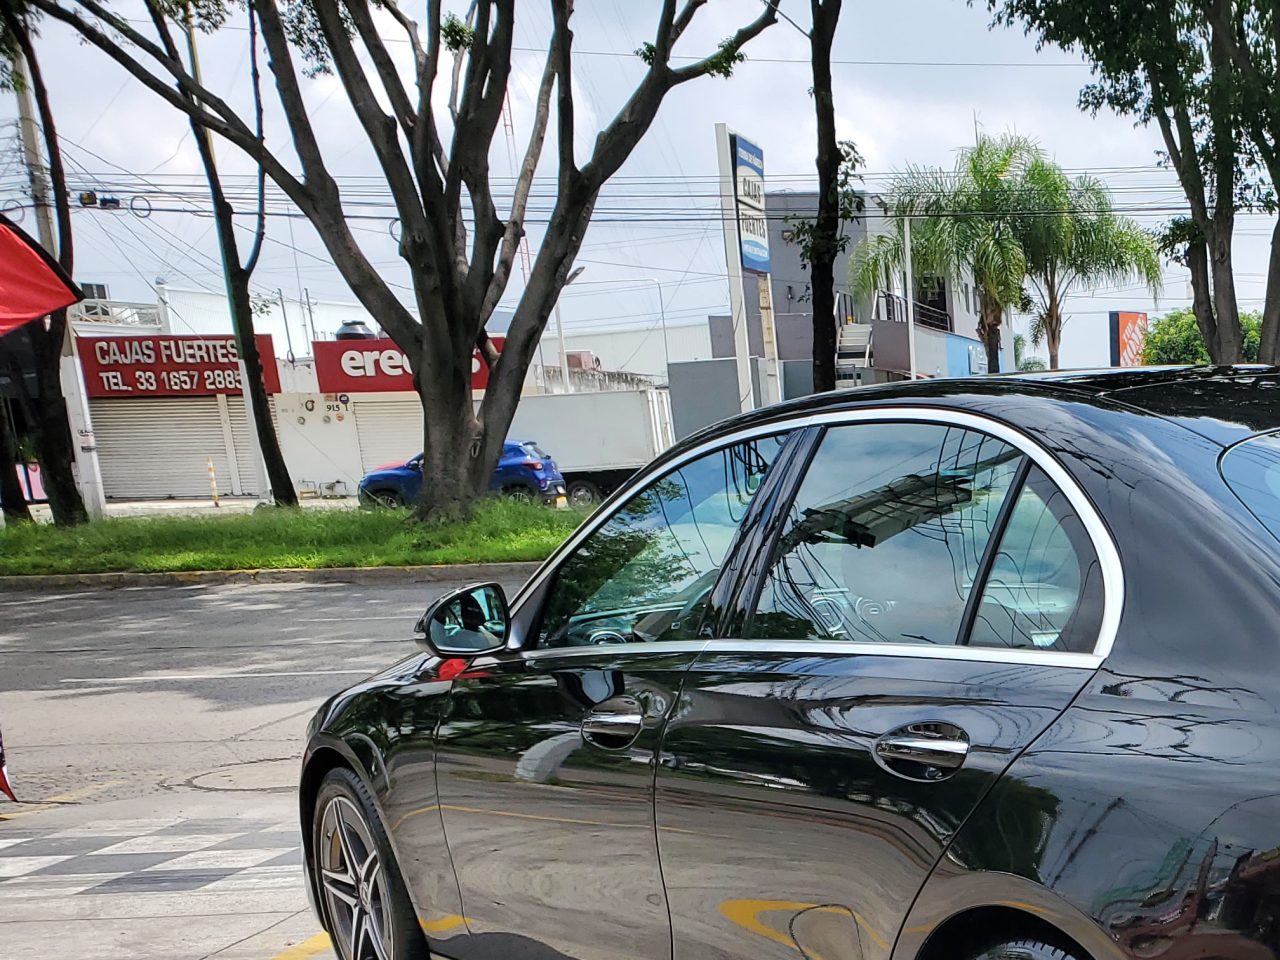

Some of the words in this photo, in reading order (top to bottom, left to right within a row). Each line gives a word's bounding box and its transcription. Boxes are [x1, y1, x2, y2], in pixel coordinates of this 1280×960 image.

[742, 177, 761, 204] CAJAS
[95, 340, 156, 365] CAJAS
[159, 339, 238, 364] FUERTES
[98, 371, 133, 391] TEL.
[135, 371, 157, 391] 33
[160, 370, 199, 390] 1657
